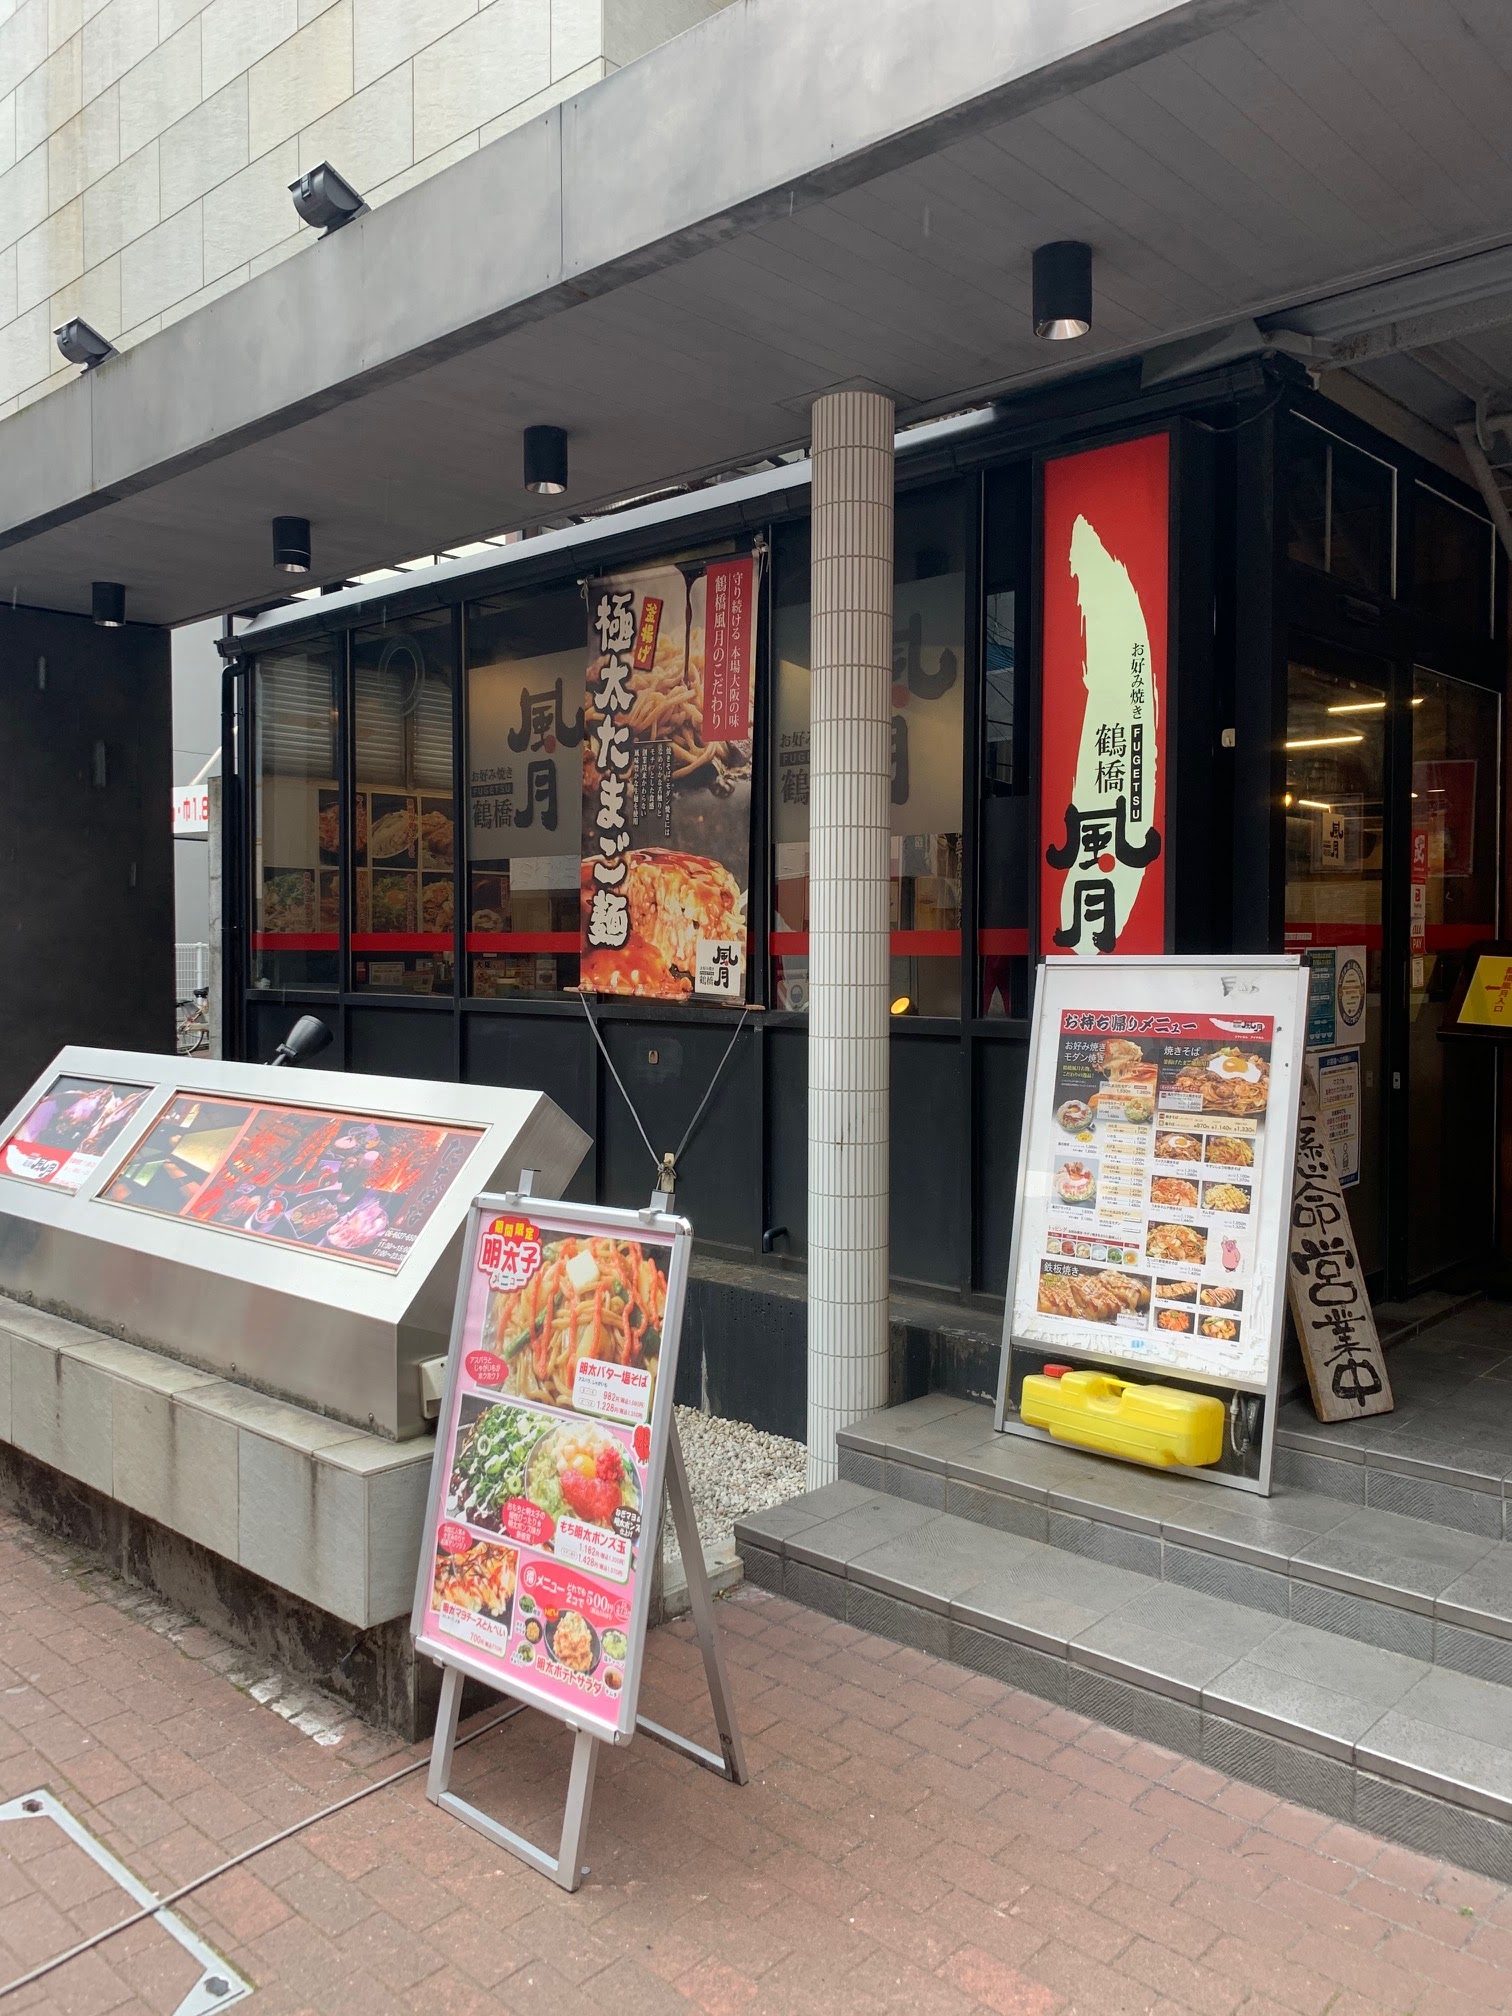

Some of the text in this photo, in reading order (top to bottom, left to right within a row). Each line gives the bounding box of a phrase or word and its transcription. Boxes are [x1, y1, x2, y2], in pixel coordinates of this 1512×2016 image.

[637, 602, 658, 664] 釜揚げ
[728, 572, 744, 728] 守り続ける 本場大阪の味
[711, 575, 728, 729] 鶴橋風月のこだわり
[1130, 643, 1146, 720] お好み焼き
[508, 677, 584, 831] 風月
[588, 593, 635, 946] 極太たまご麺
[782, 751, 810, 764] FUG
[1095, 722, 1127, 794] 鶴橋
[472, 766, 512, 782] お好み焼き
[1132, 726, 1142, 821] FUGETSU
[472, 798, 512, 830] 鶴橋
[1046, 795, 1162, 954] 風月
[1412, 938, 1422, 950] PAY
[712, 945, 738, 988] 風月
[1063, 1012, 1198, 1034] お持ち帰りメニュー
[1064, 1052, 1104, 1064] モダン焼き
[1065, 1042, 1106, 1052] お好み焼き
[1164, 1046, 1202, 1056] 焼きそば
[494, 1220, 535, 1241] 期間限定
[482, 1238, 540, 1274] 明太子
[1044, 1262, 1080, 1276] 鉄板焼き
[492, 1272, 524, 1287] メニュー
[579, 1362, 648, 1388] 明太バター塩そば
[560, 1520, 627, 1554] もち明太ポンズ玉
[536, 1656, 602, 1694] 明太ポテトサラダ
